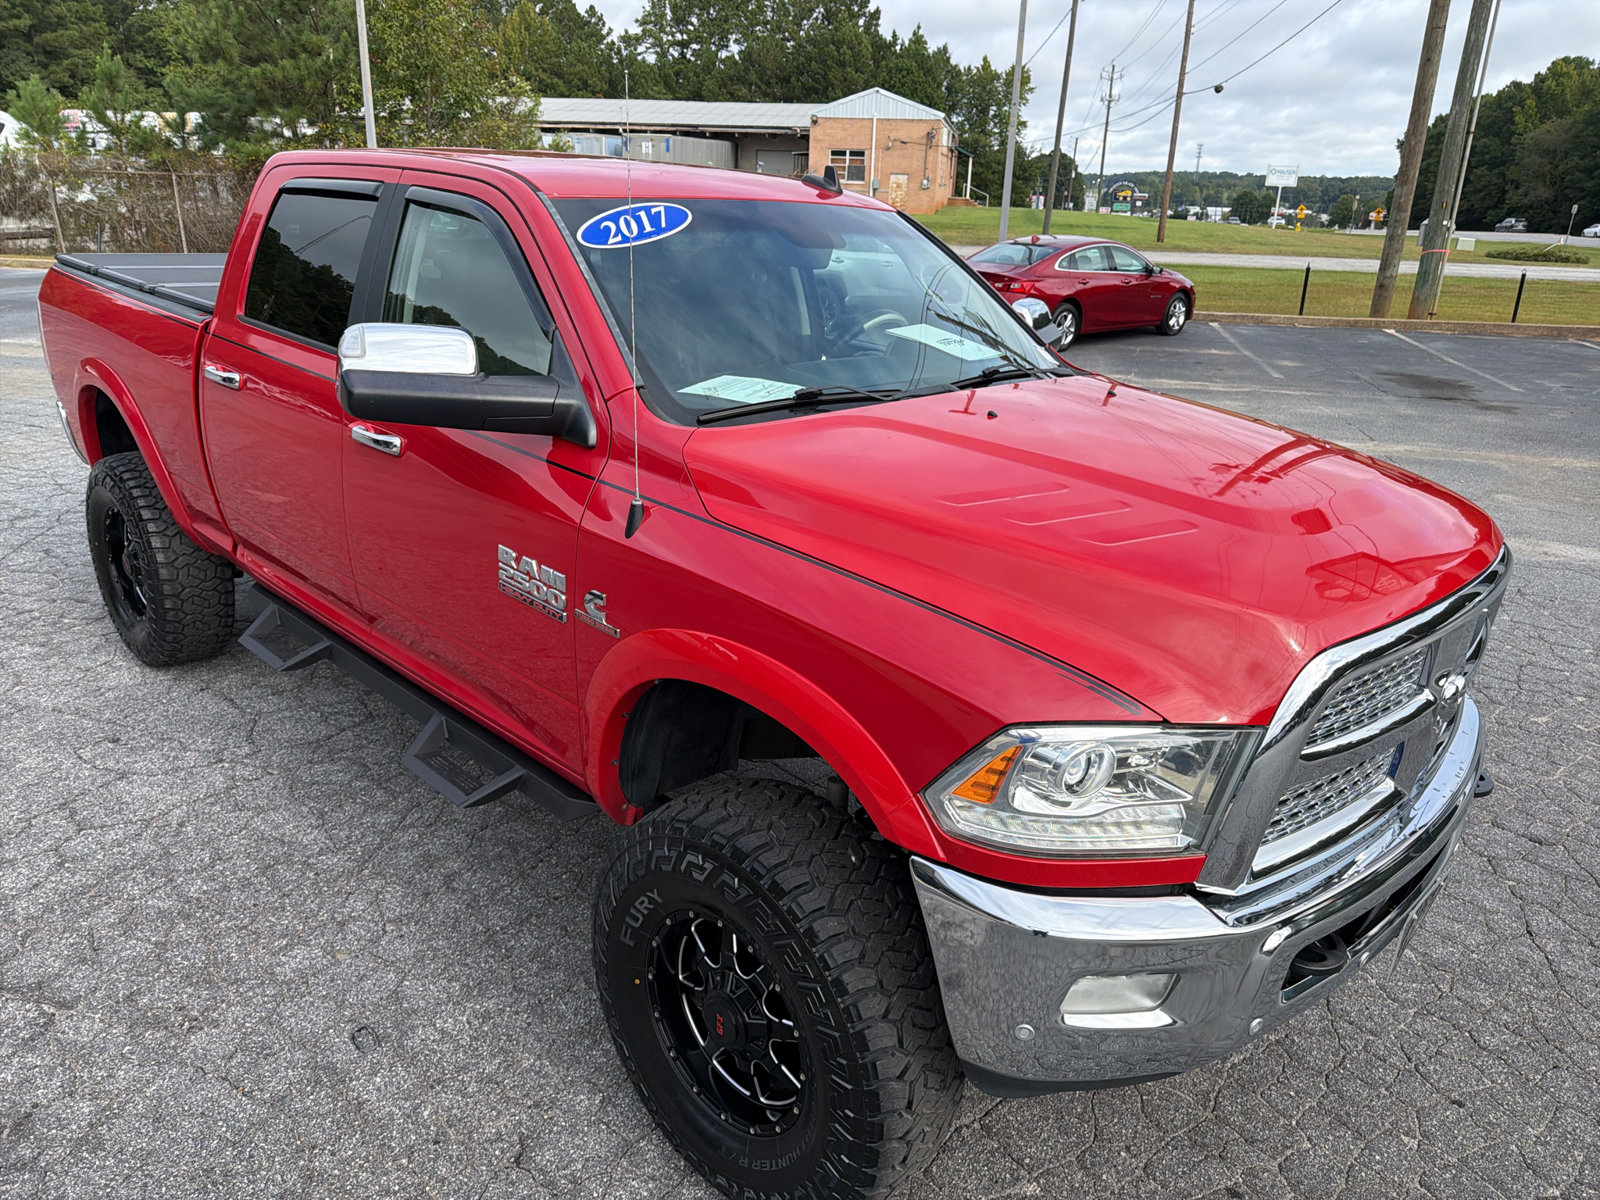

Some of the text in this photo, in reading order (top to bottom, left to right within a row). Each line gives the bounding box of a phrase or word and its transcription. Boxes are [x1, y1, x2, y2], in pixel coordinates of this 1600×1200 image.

[600, 205, 666, 244] 2017
[498, 544, 566, 592] RAM
[498, 562, 566, 610] 2500
[620, 888, 664, 946] FURY
[752, 1147, 800, 1170] HUNTER
